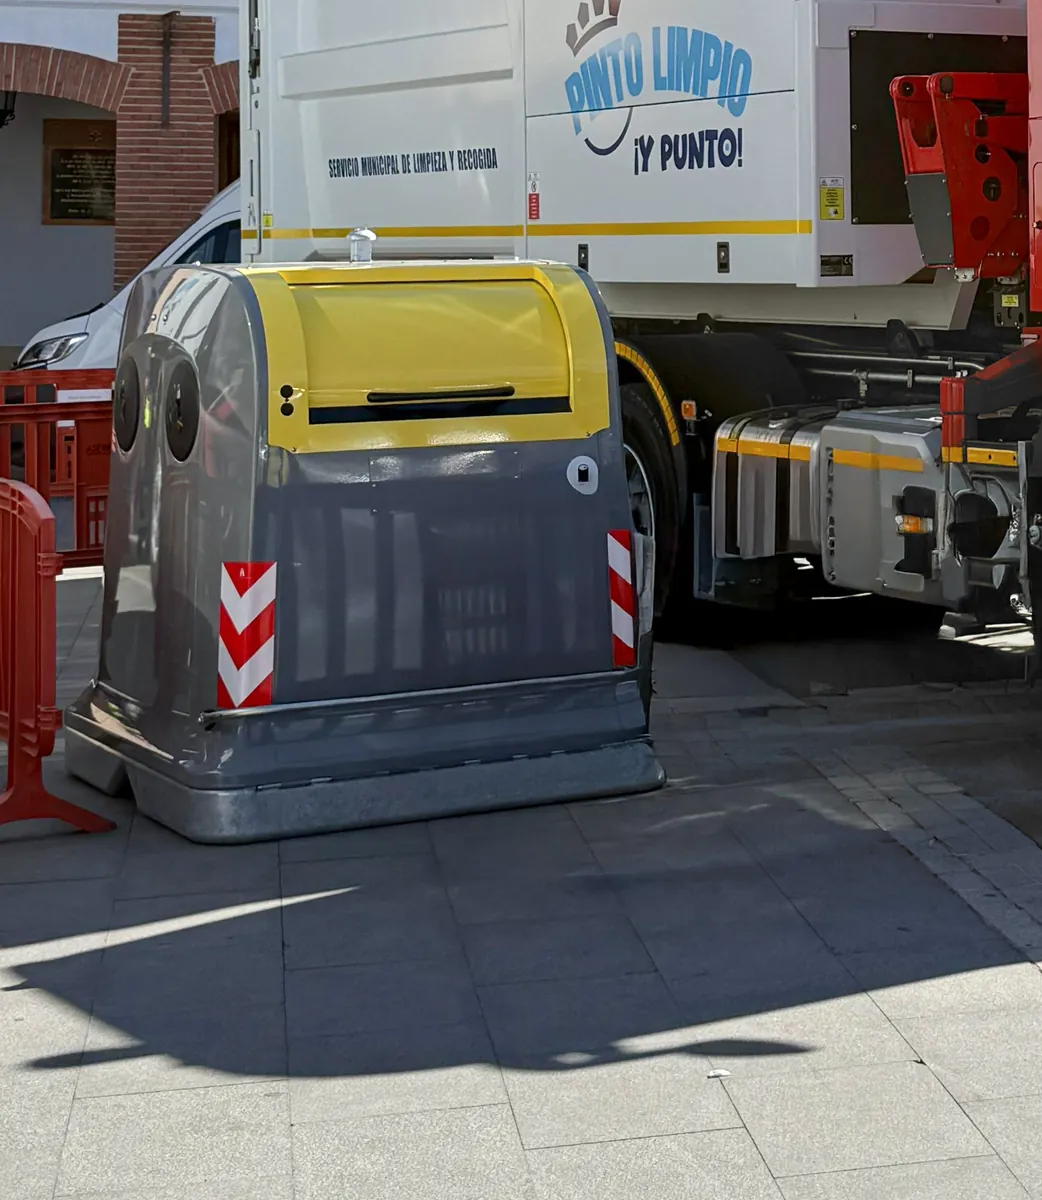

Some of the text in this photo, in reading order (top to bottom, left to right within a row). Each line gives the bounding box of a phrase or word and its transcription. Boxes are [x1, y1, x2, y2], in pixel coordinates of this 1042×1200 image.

[564, 25, 752, 136] PINTO LIMPIO
[328, 147, 498, 178] SERVICIO MUNICIPAL DE LIMPIEZA Y RECOGIDA
[634, 127, 743, 175] ¡Y PUNTO!
